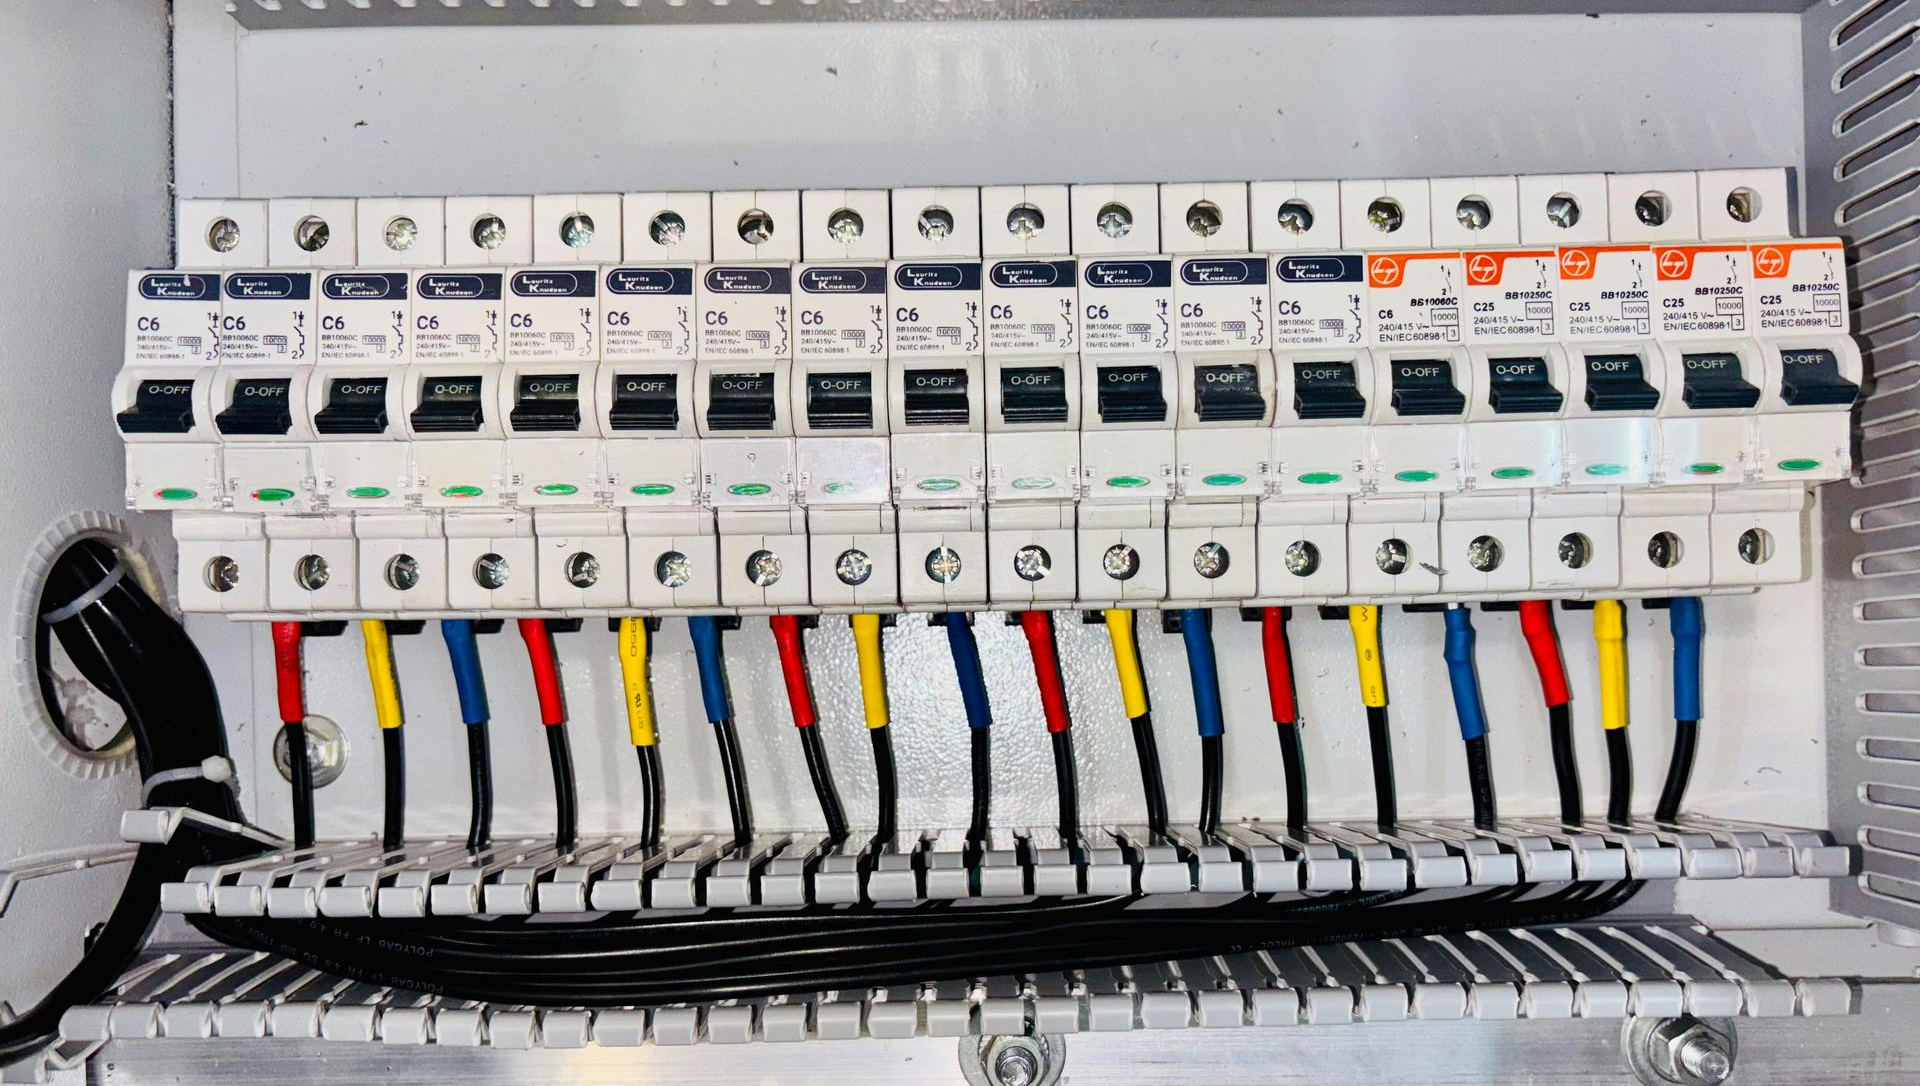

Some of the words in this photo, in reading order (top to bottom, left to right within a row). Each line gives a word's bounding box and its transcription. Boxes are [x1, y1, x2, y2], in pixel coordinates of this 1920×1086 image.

[1199, 273, 1237, 281] Knudsen
[1295, 270, 1334, 278] Knudsen
[914, 278, 952, 286] Knudsen
[1009, 275, 1048, 284] Knudsen
[1104, 275, 1142, 283] Knudsen
[529, 284, 568, 293] Knudsen
[625, 282, 664, 291] Knudsen
[723, 281, 762, 289] Knudsen
[818, 281, 857, 289] Knudsen
[1792, 283, 1840, 292] BB10250C
[158, 287, 196, 296] Knudsen
[244, 287, 282, 295] Knudsen
[342, 287, 380, 296] Knudsen
[436, 287, 474, 295] Knudsen
[1601, 291, 1648, 299] BB10250C
[1695, 287, 1743, 295] BB10250C
[1505, 292, 1552, 300] BB10250C
[1761, 296, 1782, 304] C25
[1410, 298, 1458, 306] BB10060C
[1663, 299, 1684, 307] C25
[1181, 303, 1203, 318] C6
[1279, 301, 1301, 315] C6
[1474, 303, 1494, 311] C25
[1570, 303, 1590, 311] C25
[1624, 306, 1647, 314] 10000
[896, 308, 919, 322] C6
[990, 305, 1013, 319] C6
[1086, 305, 1109, 320] C6
[1379, 310, 1393, 319] C6
[1663, 312, 1698, 320] 240/415
[1761, 309, 1795, 317] 240/415
[511, 313, 533, 328] C6
[607, 311, 630, 326] C6
[706, 311, 728, 325] C6
[801, 310, 824, 325] C6
[1433, 313, 1457, 321] 10000
[1570, 316, 1604, 324] 240/415
[1833, 315, 1838, 323] 3
[137, 317, 160, 331] C6
[223, 316, 246, 331] C6
[322, 316, 345, 330] C6
[417, 315, 440, 330] C6
[1379, 324, 1413, 332] 240/415
[1450, 330, 1456, 338] 3
[378, 939, 433, 957] POLYCAB
[391, 976, 443, 994] POLYCAB
